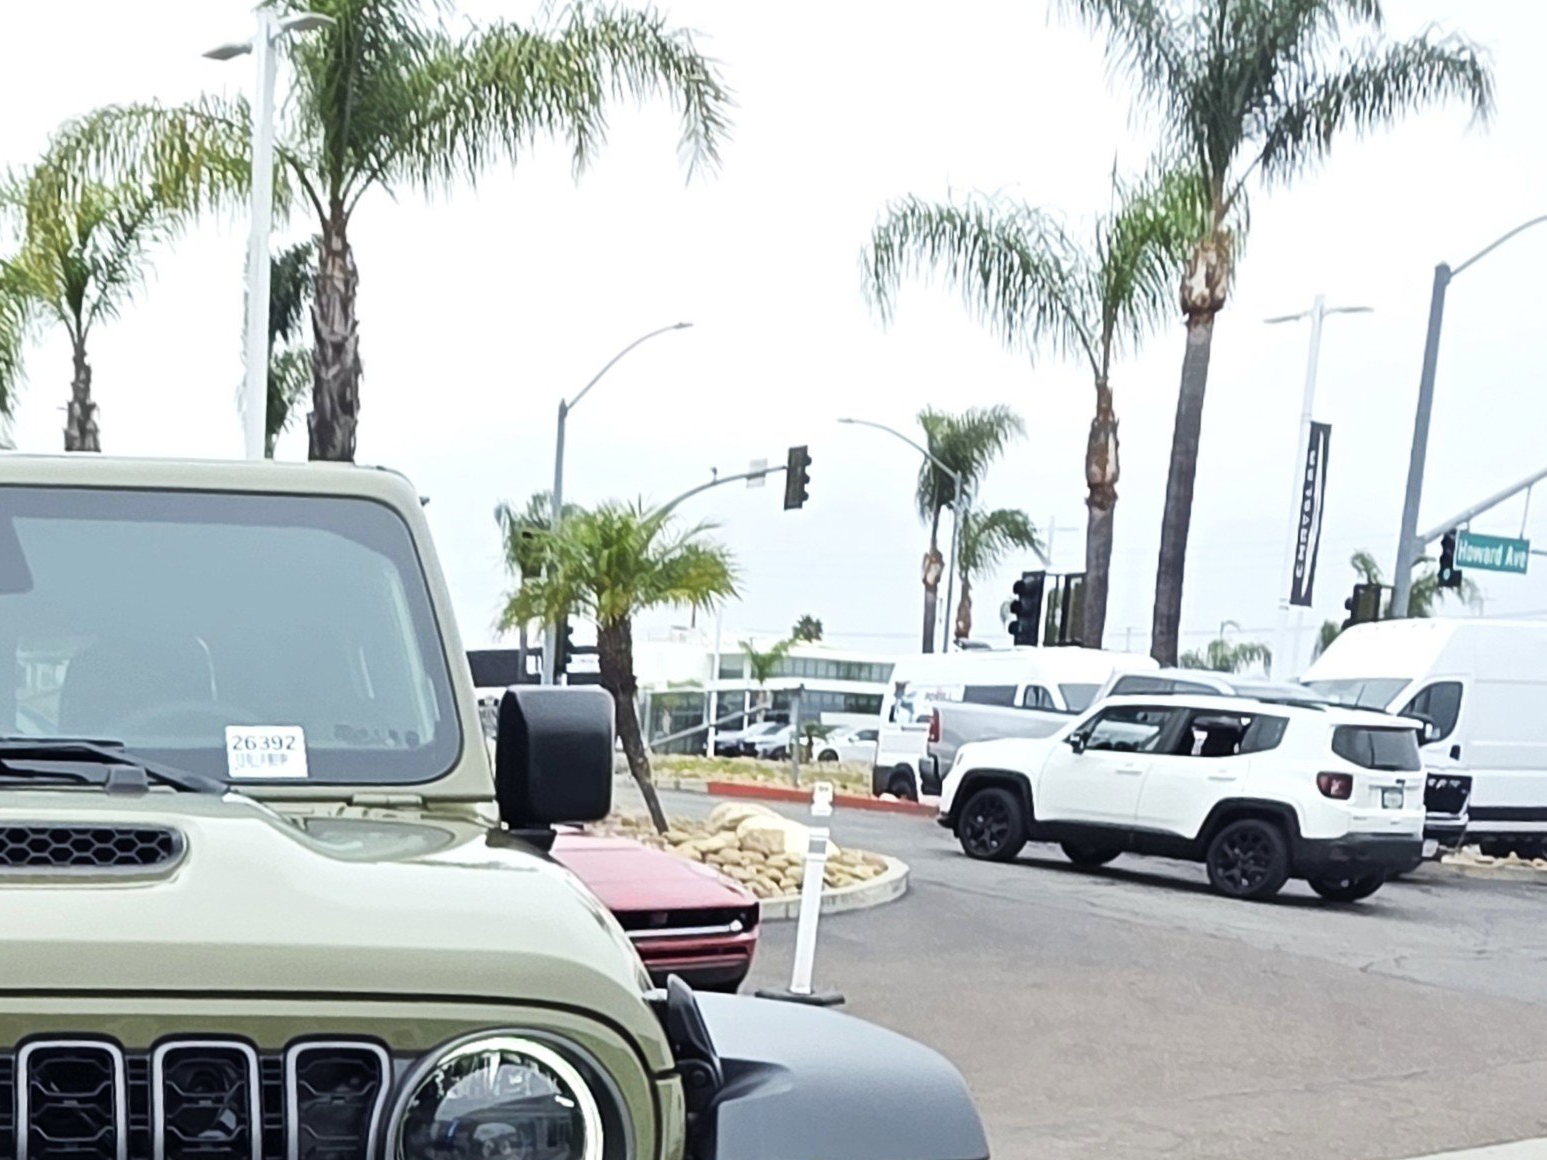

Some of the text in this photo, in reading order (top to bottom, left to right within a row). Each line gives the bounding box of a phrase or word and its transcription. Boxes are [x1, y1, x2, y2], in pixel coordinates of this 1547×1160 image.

[1457, 539, 1527, 569] Howard Ave
[232, 735, 297, 751] 26392
